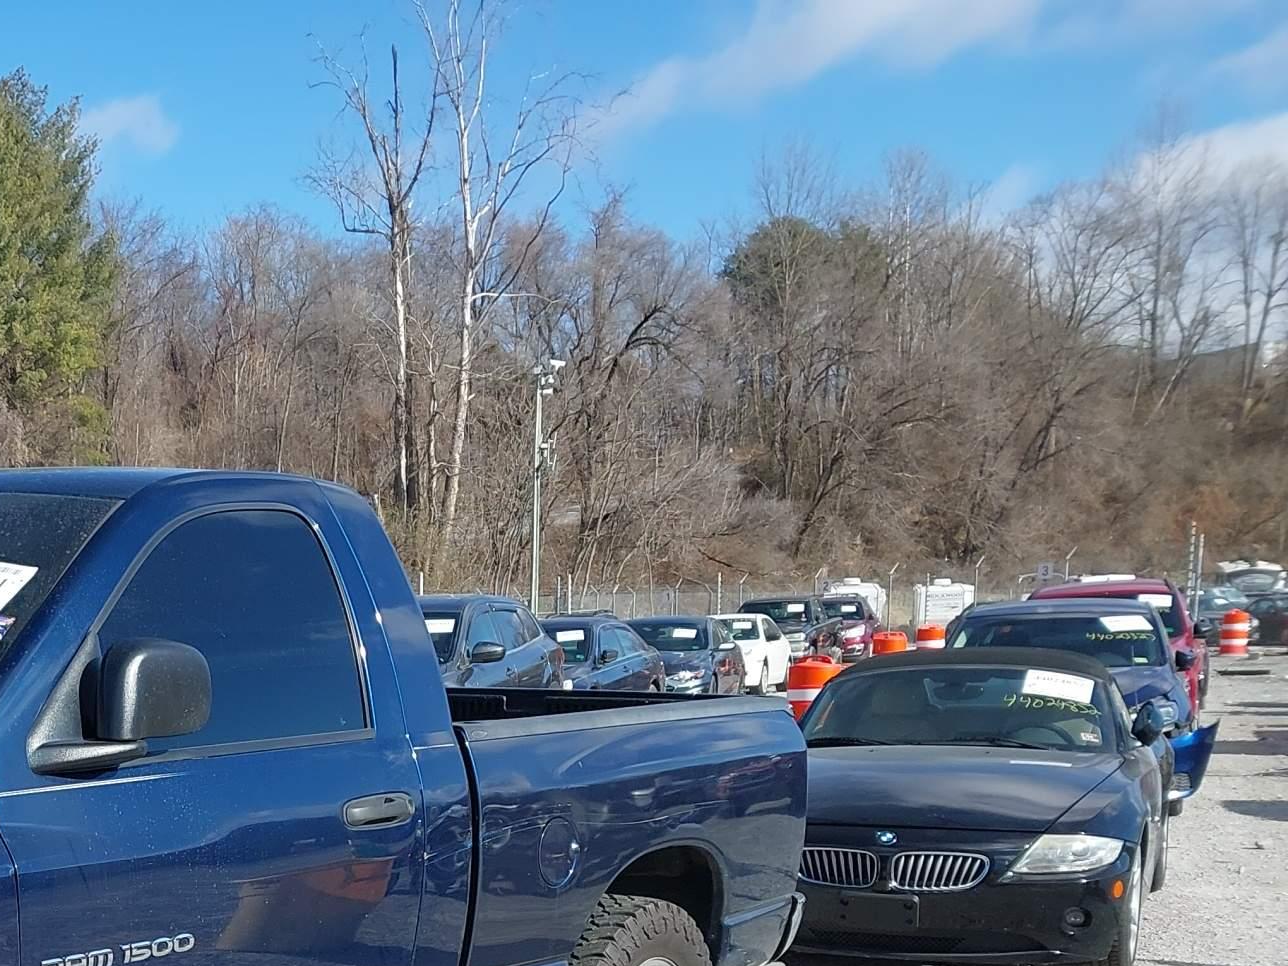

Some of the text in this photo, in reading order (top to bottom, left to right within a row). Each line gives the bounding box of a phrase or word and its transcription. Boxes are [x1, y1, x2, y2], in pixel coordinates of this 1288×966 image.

[1041, 565, 1049, 577] 3
[823, 581, 830, 593] 2
[120, 933, 196, 964] 1500
